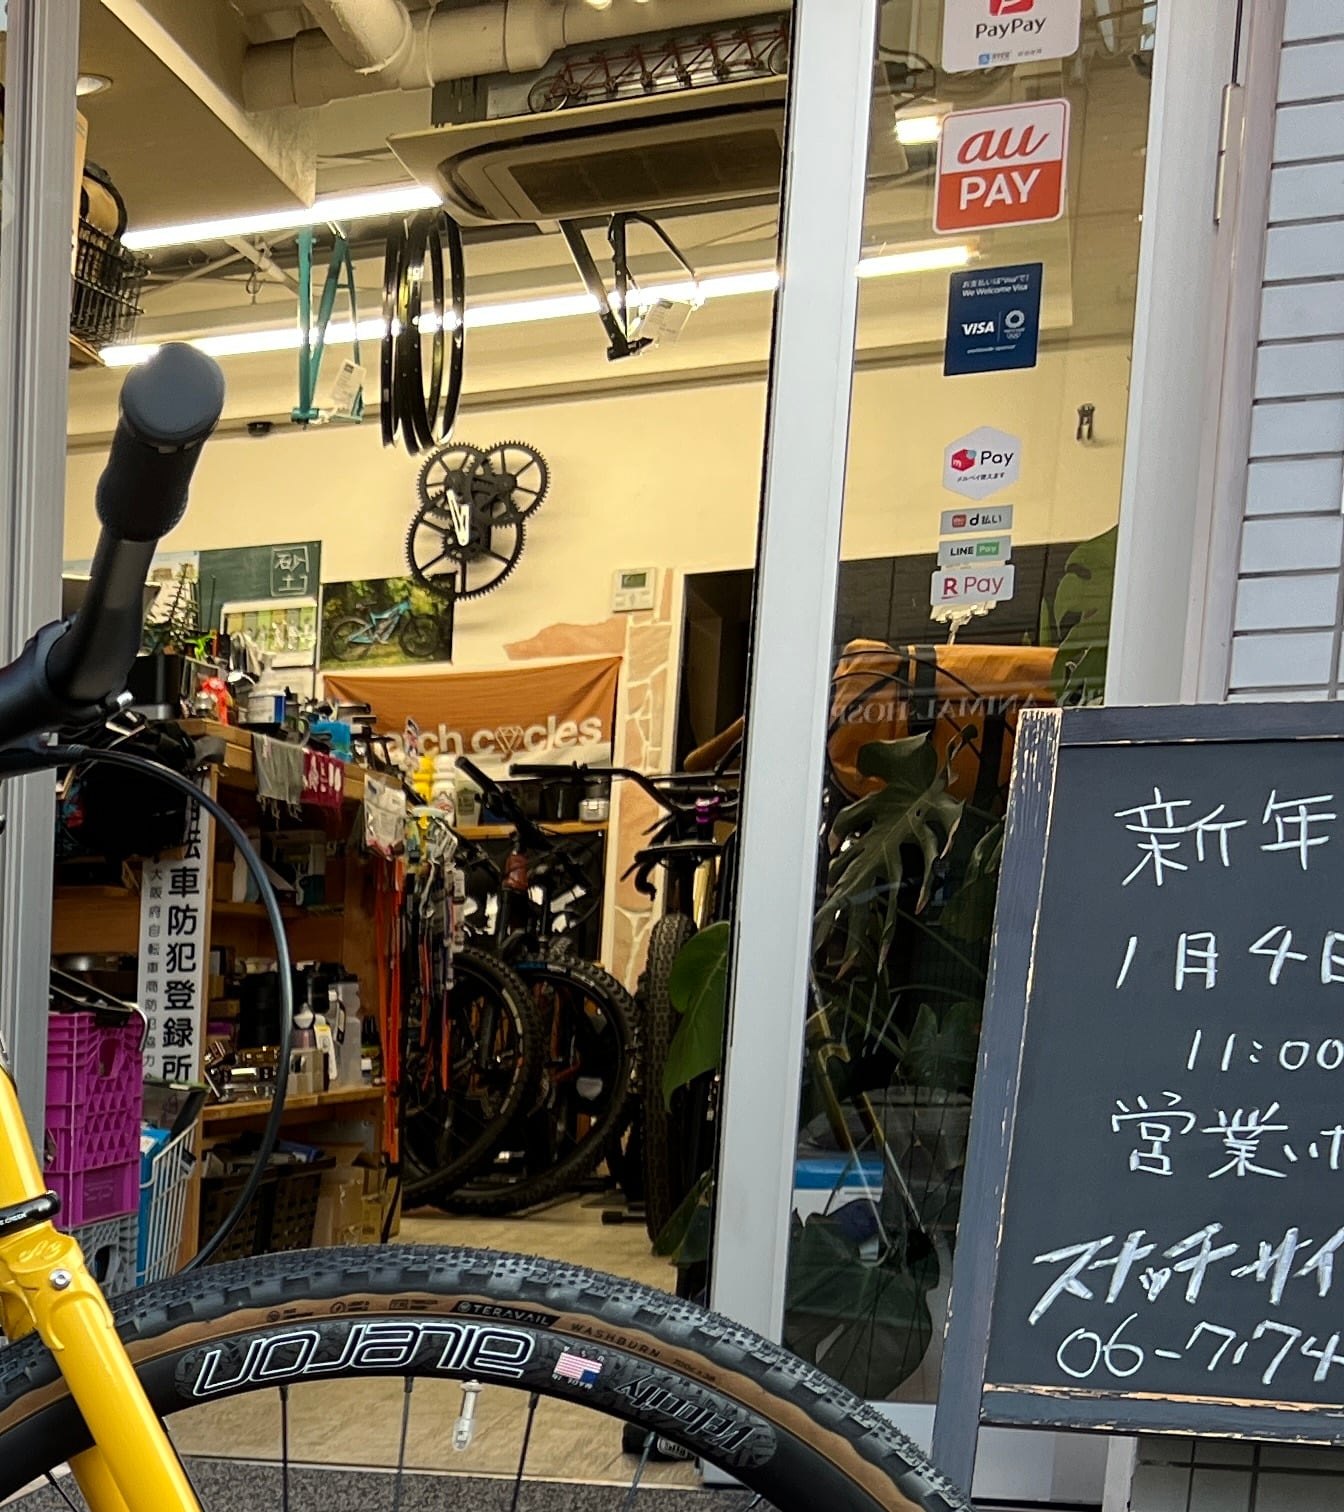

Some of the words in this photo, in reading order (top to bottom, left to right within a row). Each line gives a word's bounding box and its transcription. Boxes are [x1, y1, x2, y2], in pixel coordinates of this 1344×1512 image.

[975, 16, 1048, 39] PayPay
[957, 124, 1050, 164] au
[959, 168, 1043, 210] PAY
[961, 321, 995, 336] VISA
[980, 450, 1014, 468] Pay
[950, 546, 974, 557] LINE
[964, 576, 1004, 596] Pay
[1114, 786, 1338, 887] 新年
[473, 1303, 551, 1326] TERAVAIL
[570, 1321, 662, 1359] WASHBURN
